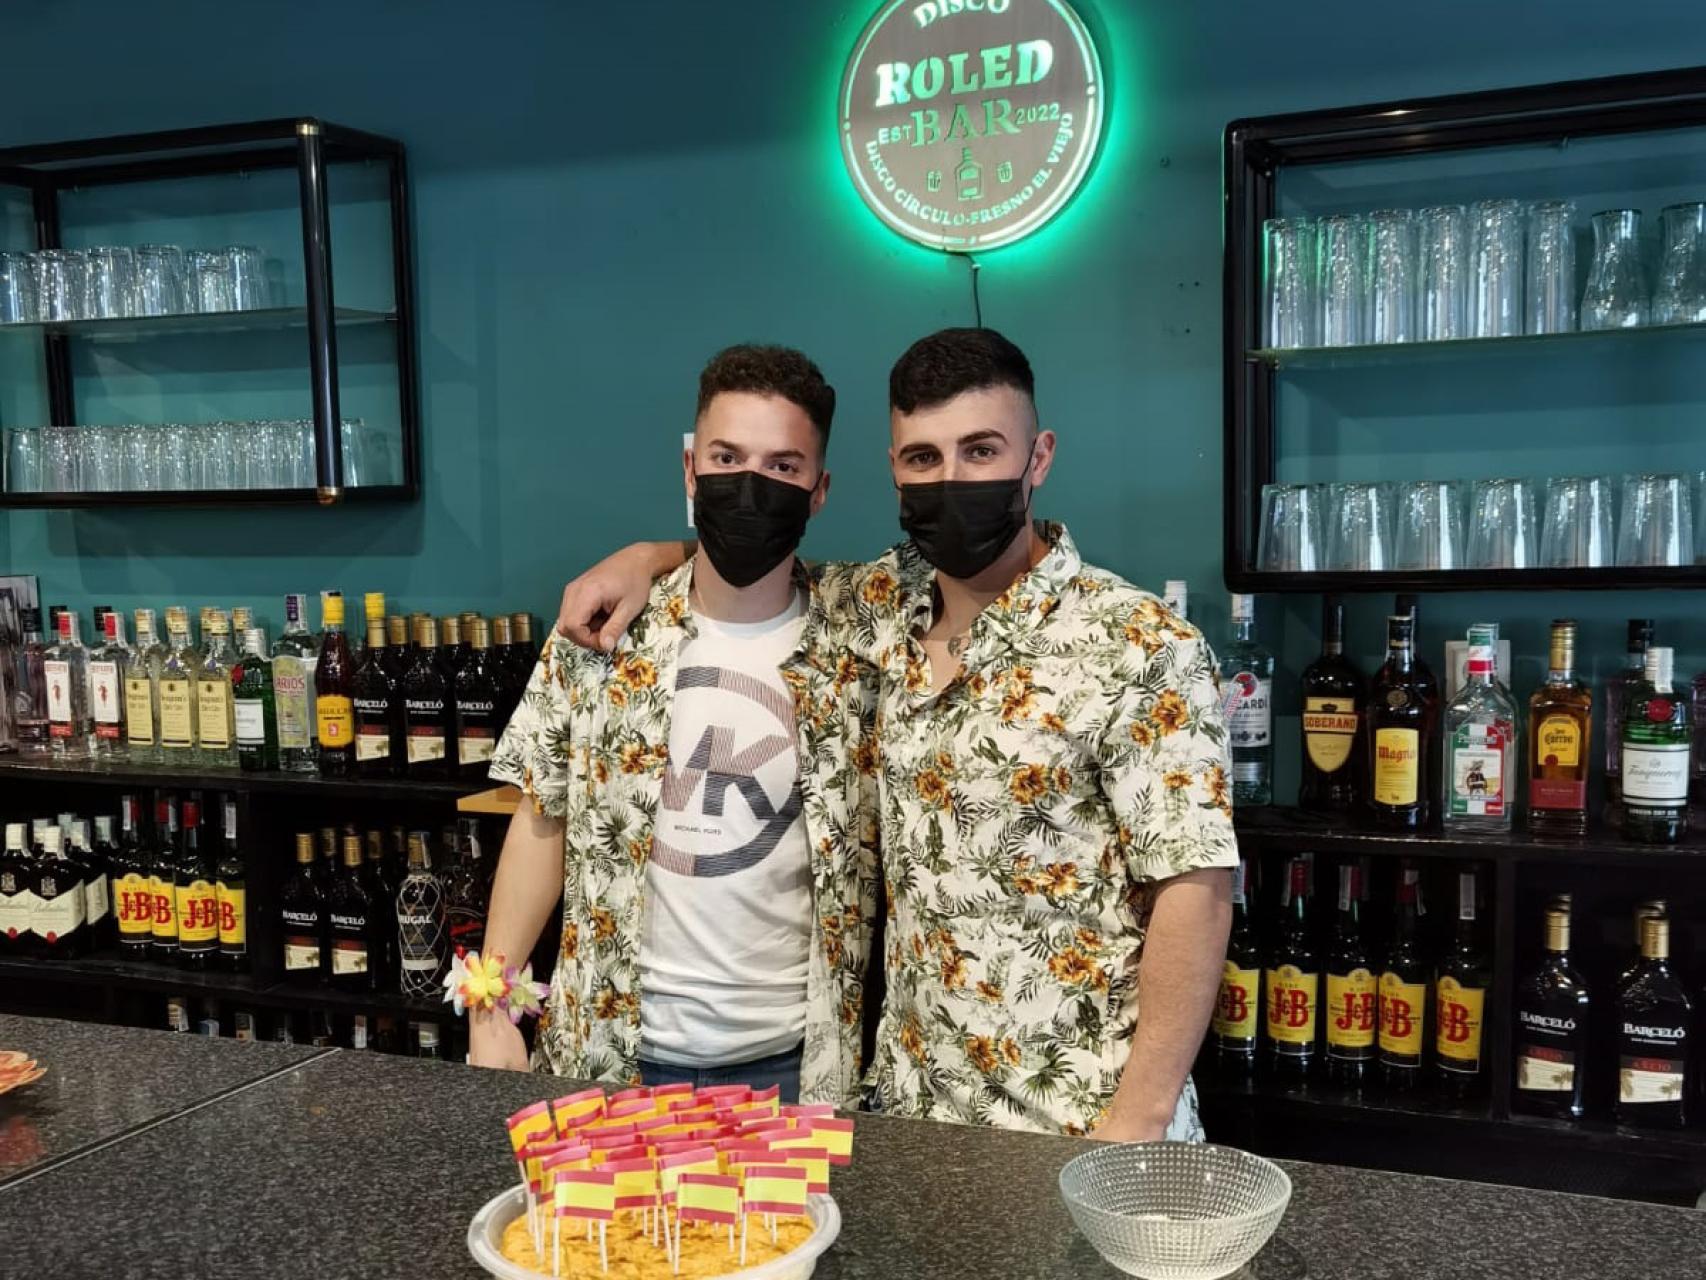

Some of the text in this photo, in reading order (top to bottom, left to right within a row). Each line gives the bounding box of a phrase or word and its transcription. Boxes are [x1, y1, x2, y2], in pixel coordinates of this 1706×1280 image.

[913, 0, 1010, 28] DISCO
[875, 40, 1054, 107] ROLED
[878, 99, 1060, 147] EST BAR 2022
[1031, 168, 1053, 189] EL
[1047, 112, 1074, 163] VIEJO
[354, 698, 388, 709] BARCELÓ
[405, 699, 444, 710] BARCELÓ
[456, 700, 494, 711] BARCELÓ
[282, 909, 318, 922] BARCELÓ
[330, 913, 366, 926] BARCELÓ
[1269, 985, 1309, 1028] J&B
[1520, 1010, 1577, 1031] BARCELÓ
[1622, 1023, 1687, 1039] BARCELÓ
